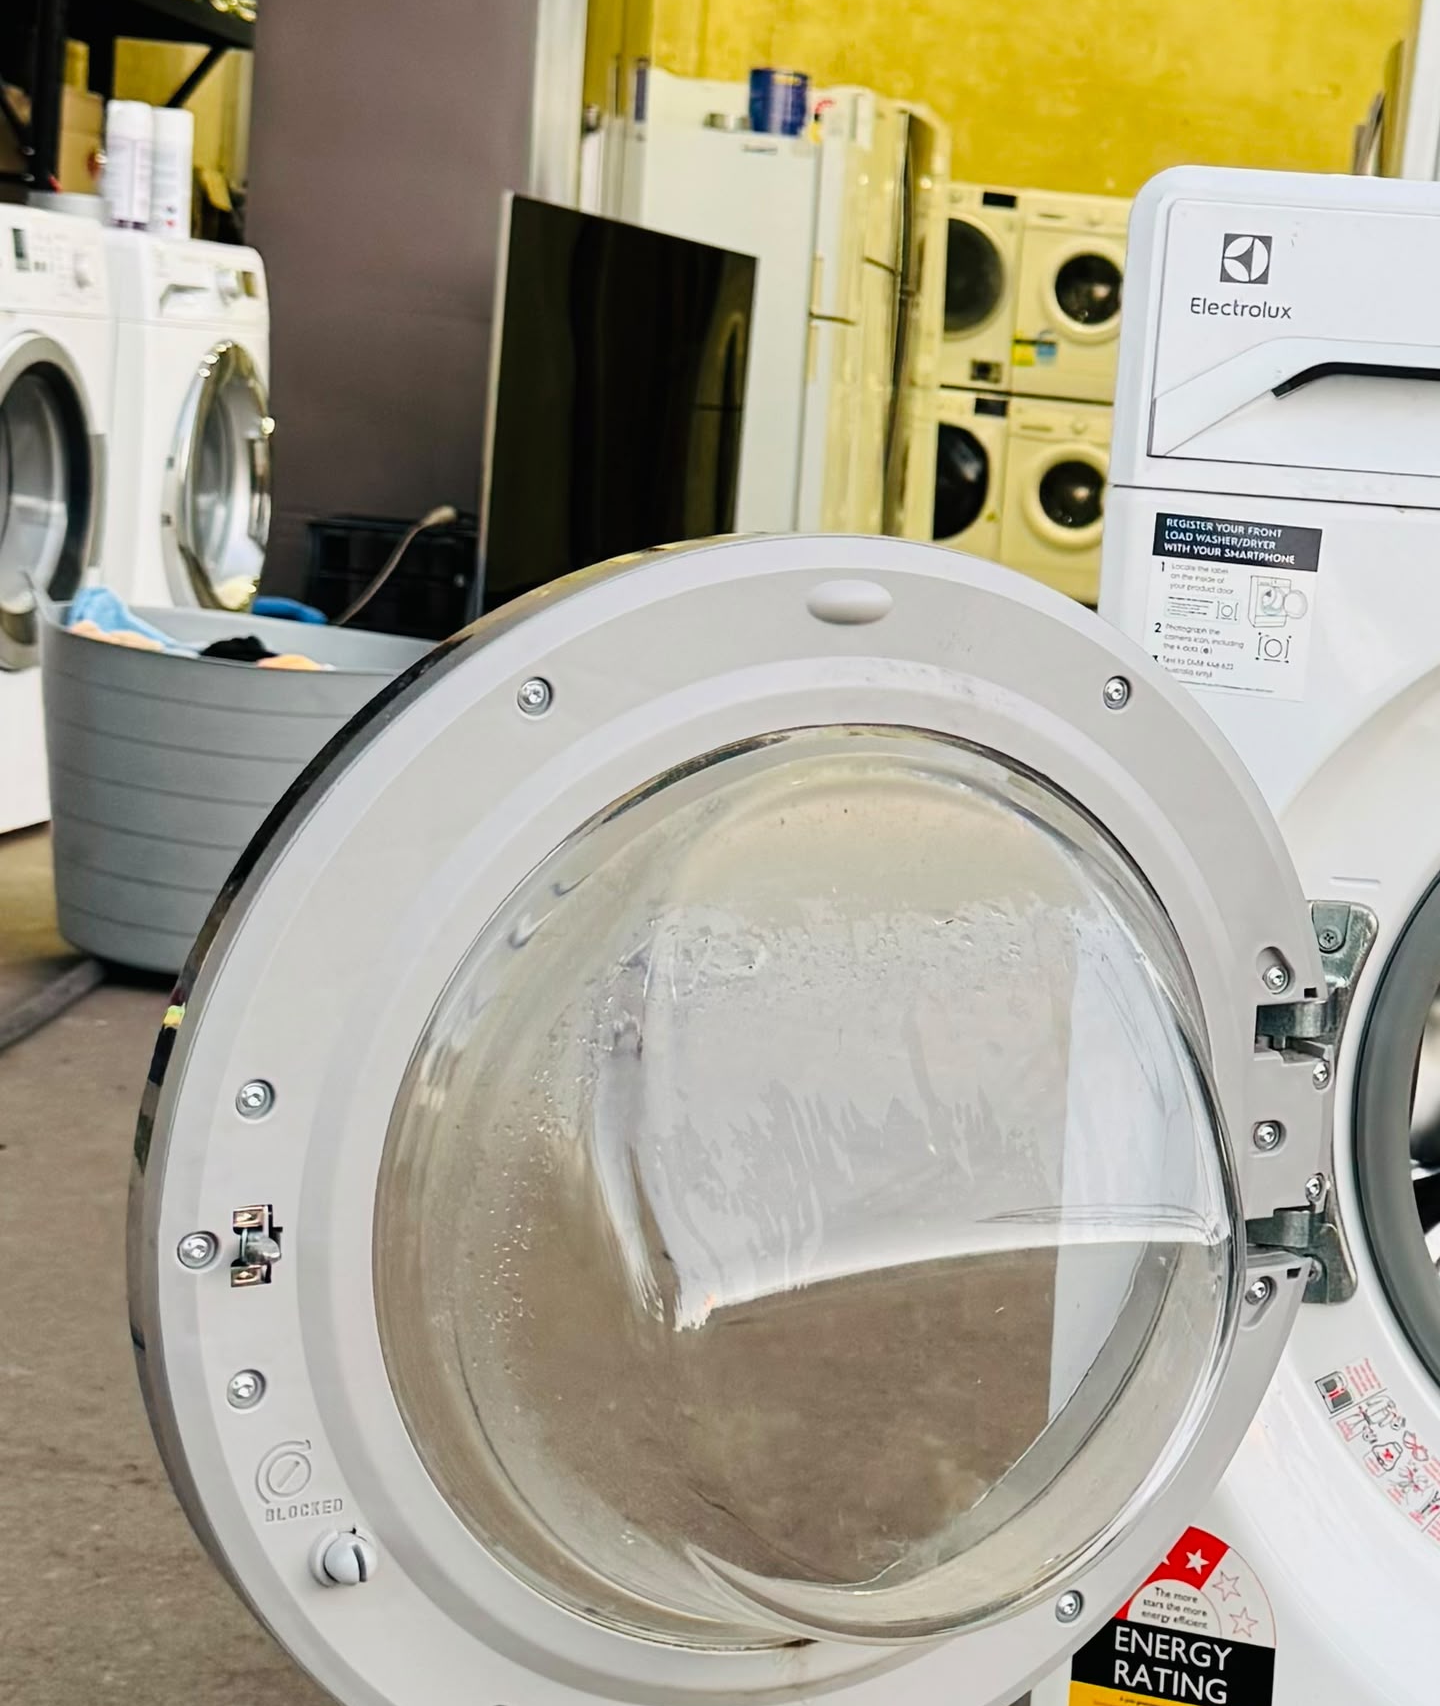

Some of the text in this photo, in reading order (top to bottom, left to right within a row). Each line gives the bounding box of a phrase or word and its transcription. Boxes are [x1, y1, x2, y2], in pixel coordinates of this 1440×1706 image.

[1190, 297, 1292, 320] Electrolux
[1166, 518, 1283, 539] REGISTER YOUR FRONT
[1165, 530, 1276, 550] LOAD WASHER/DRYER
[1163, 542, 1296, 565] WITH YOUR SMARTPHONE
[1161, 561, 1165, 572] 1
[1154, 622, 1162, 633] 2
[265, 1498, 343, 1523] BLOCKED
[1155, 1586, 1198, 1603] The more
[1143, 1599, 1208, 1617] stars the more
[1141, 1610, 1208, 1630] energy efficient
[1114, 1625, 1233, 1672] ENERGY
[1113, 1659, 1228, 1705] RATING
